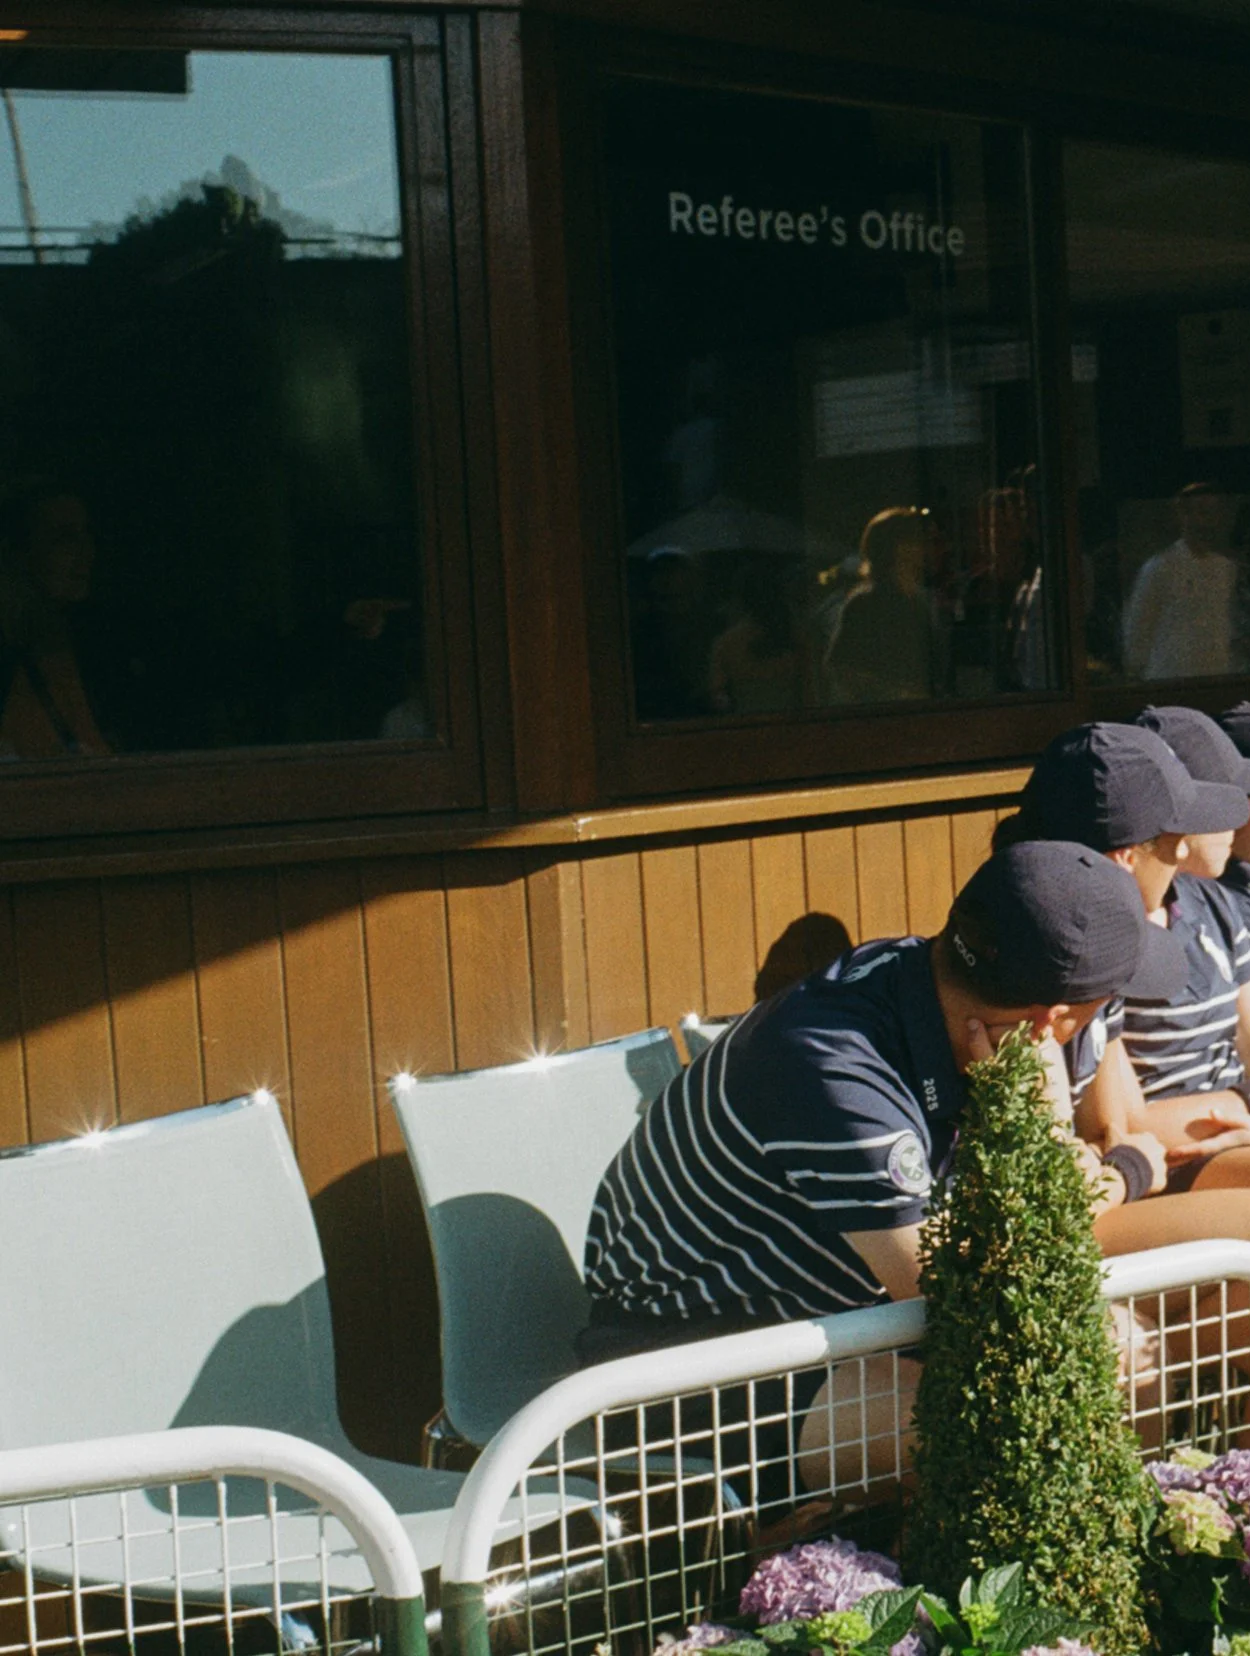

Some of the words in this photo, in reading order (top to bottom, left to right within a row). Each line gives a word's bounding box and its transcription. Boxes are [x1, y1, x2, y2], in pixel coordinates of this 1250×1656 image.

[668, 191, 847, 246] Referee's
[860, 209, 965, 256] Office
[922, 1077, 940, 1112] 2025
